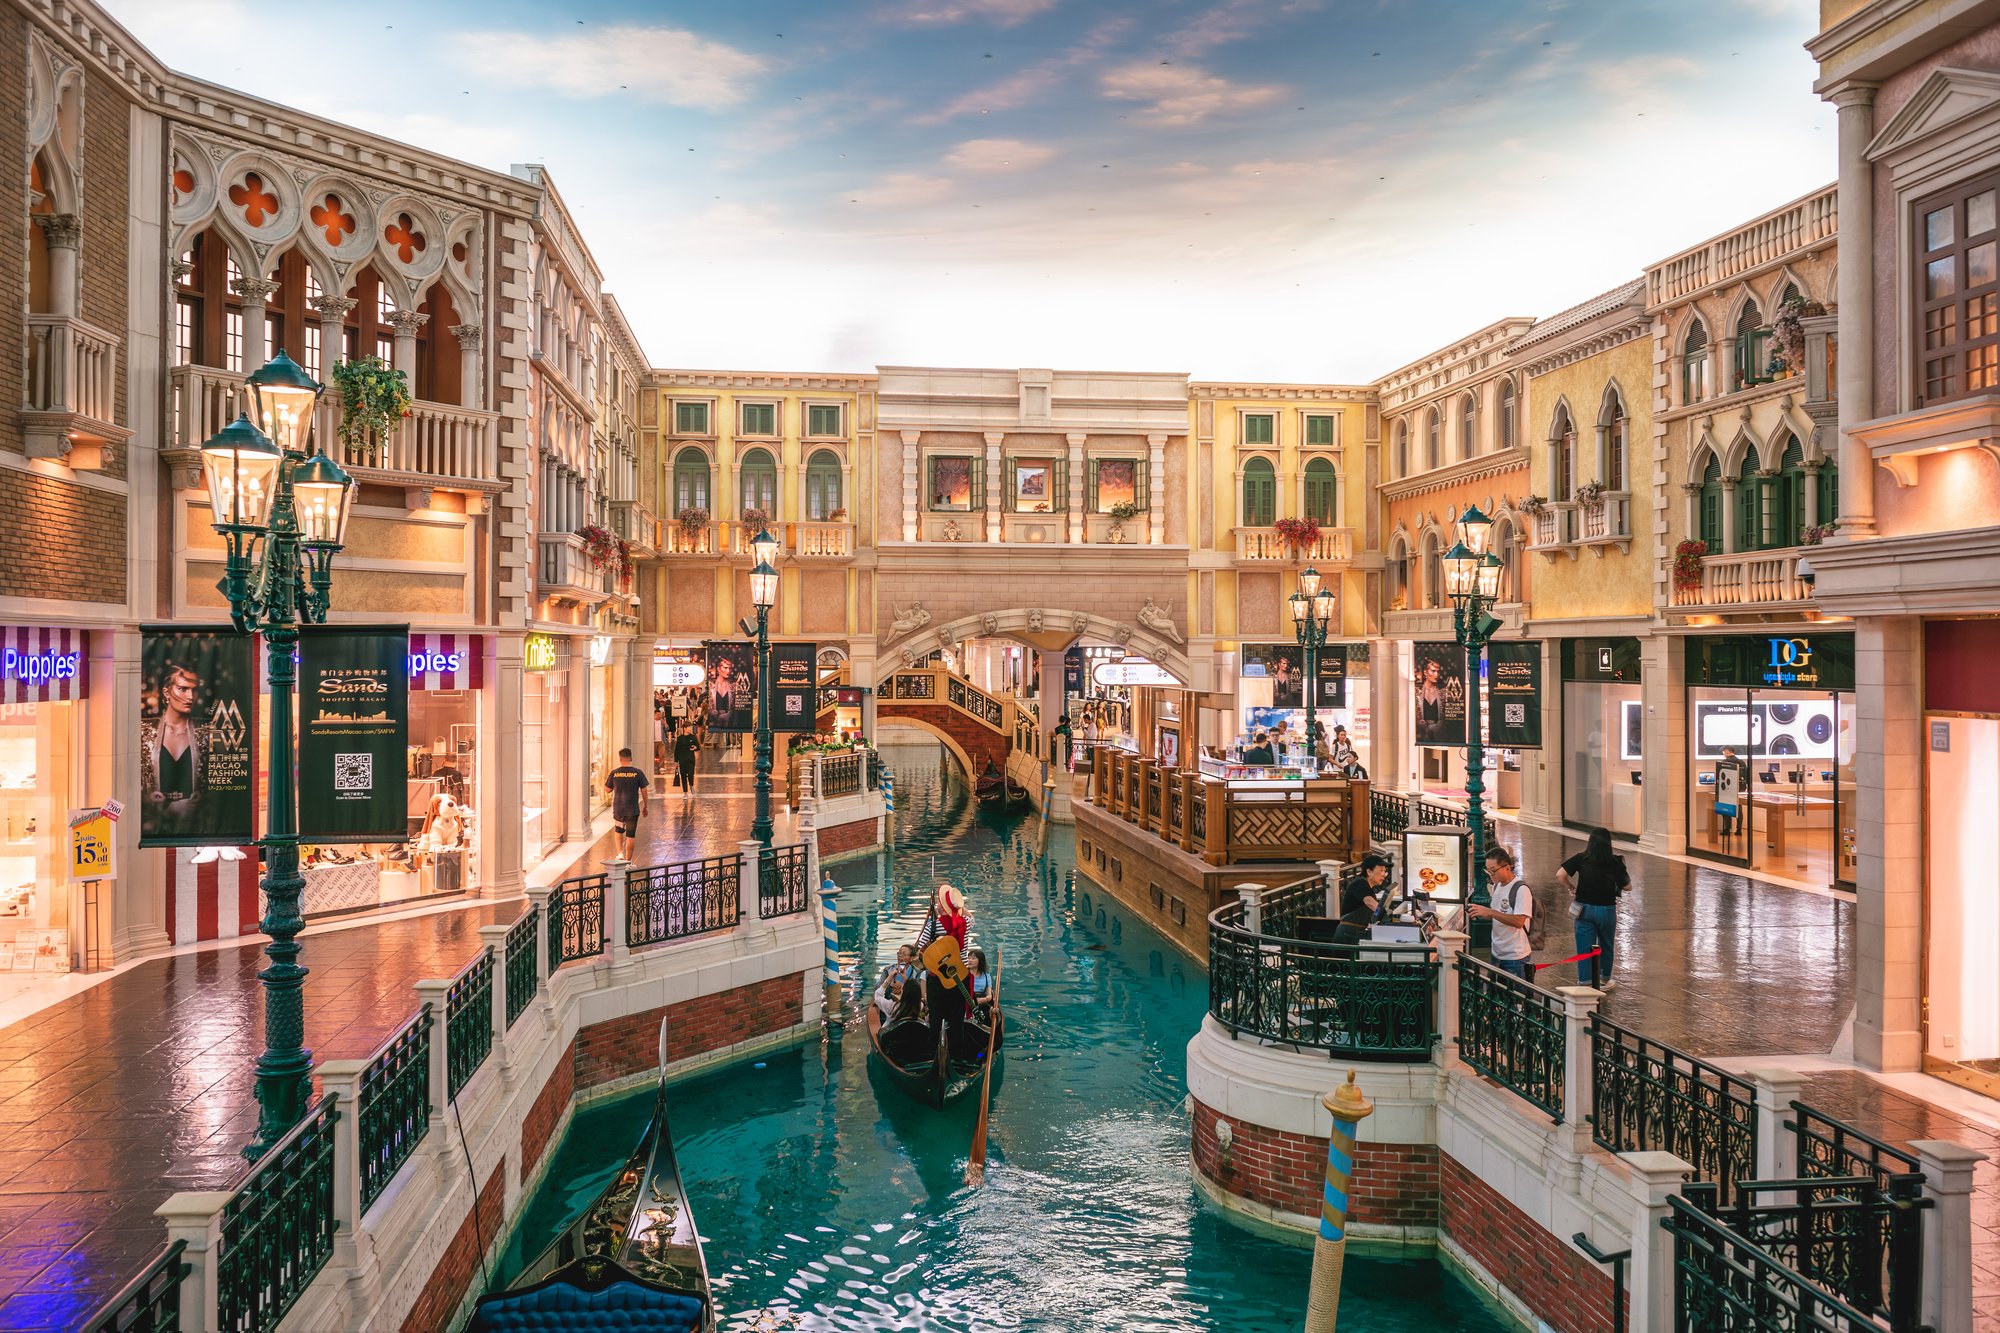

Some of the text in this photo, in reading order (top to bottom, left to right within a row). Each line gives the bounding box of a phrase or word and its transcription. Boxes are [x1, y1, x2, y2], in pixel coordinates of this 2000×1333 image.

[408, 649, 460, 677] pies
[1797, 673, 1818, 682] store
[317, 677, 388, 694] Sands
[208, 762, 241, 770] MACAO
[208, 769, 248, 777] FASHION
